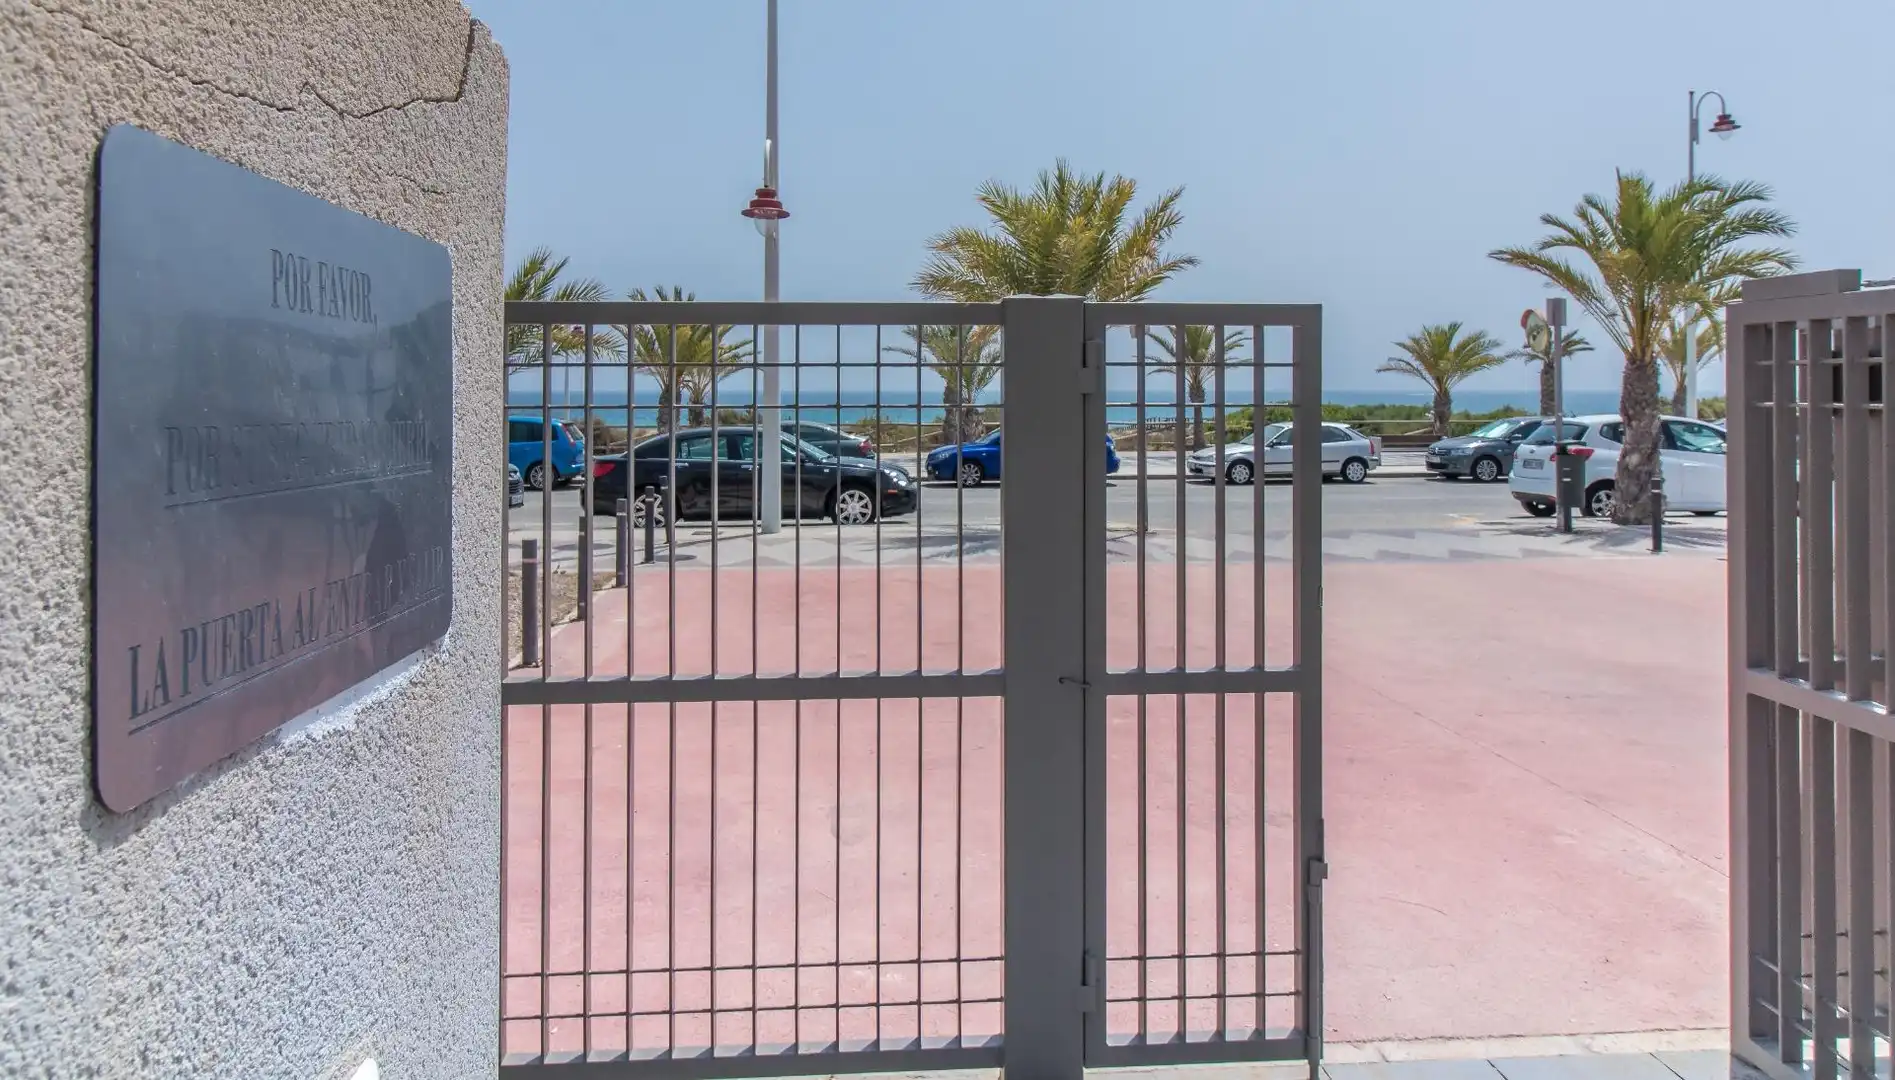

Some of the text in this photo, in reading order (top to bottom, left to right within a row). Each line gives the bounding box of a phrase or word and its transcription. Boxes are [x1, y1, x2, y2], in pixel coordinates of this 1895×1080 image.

[269, 248, 378, 337] POR FAVOR,
[164, 425, 221, 495] POR
[128, 636, 171, 720] LA
[180, 600, 285, 698] PUERTA
[293, 587, 319, 650] AL
